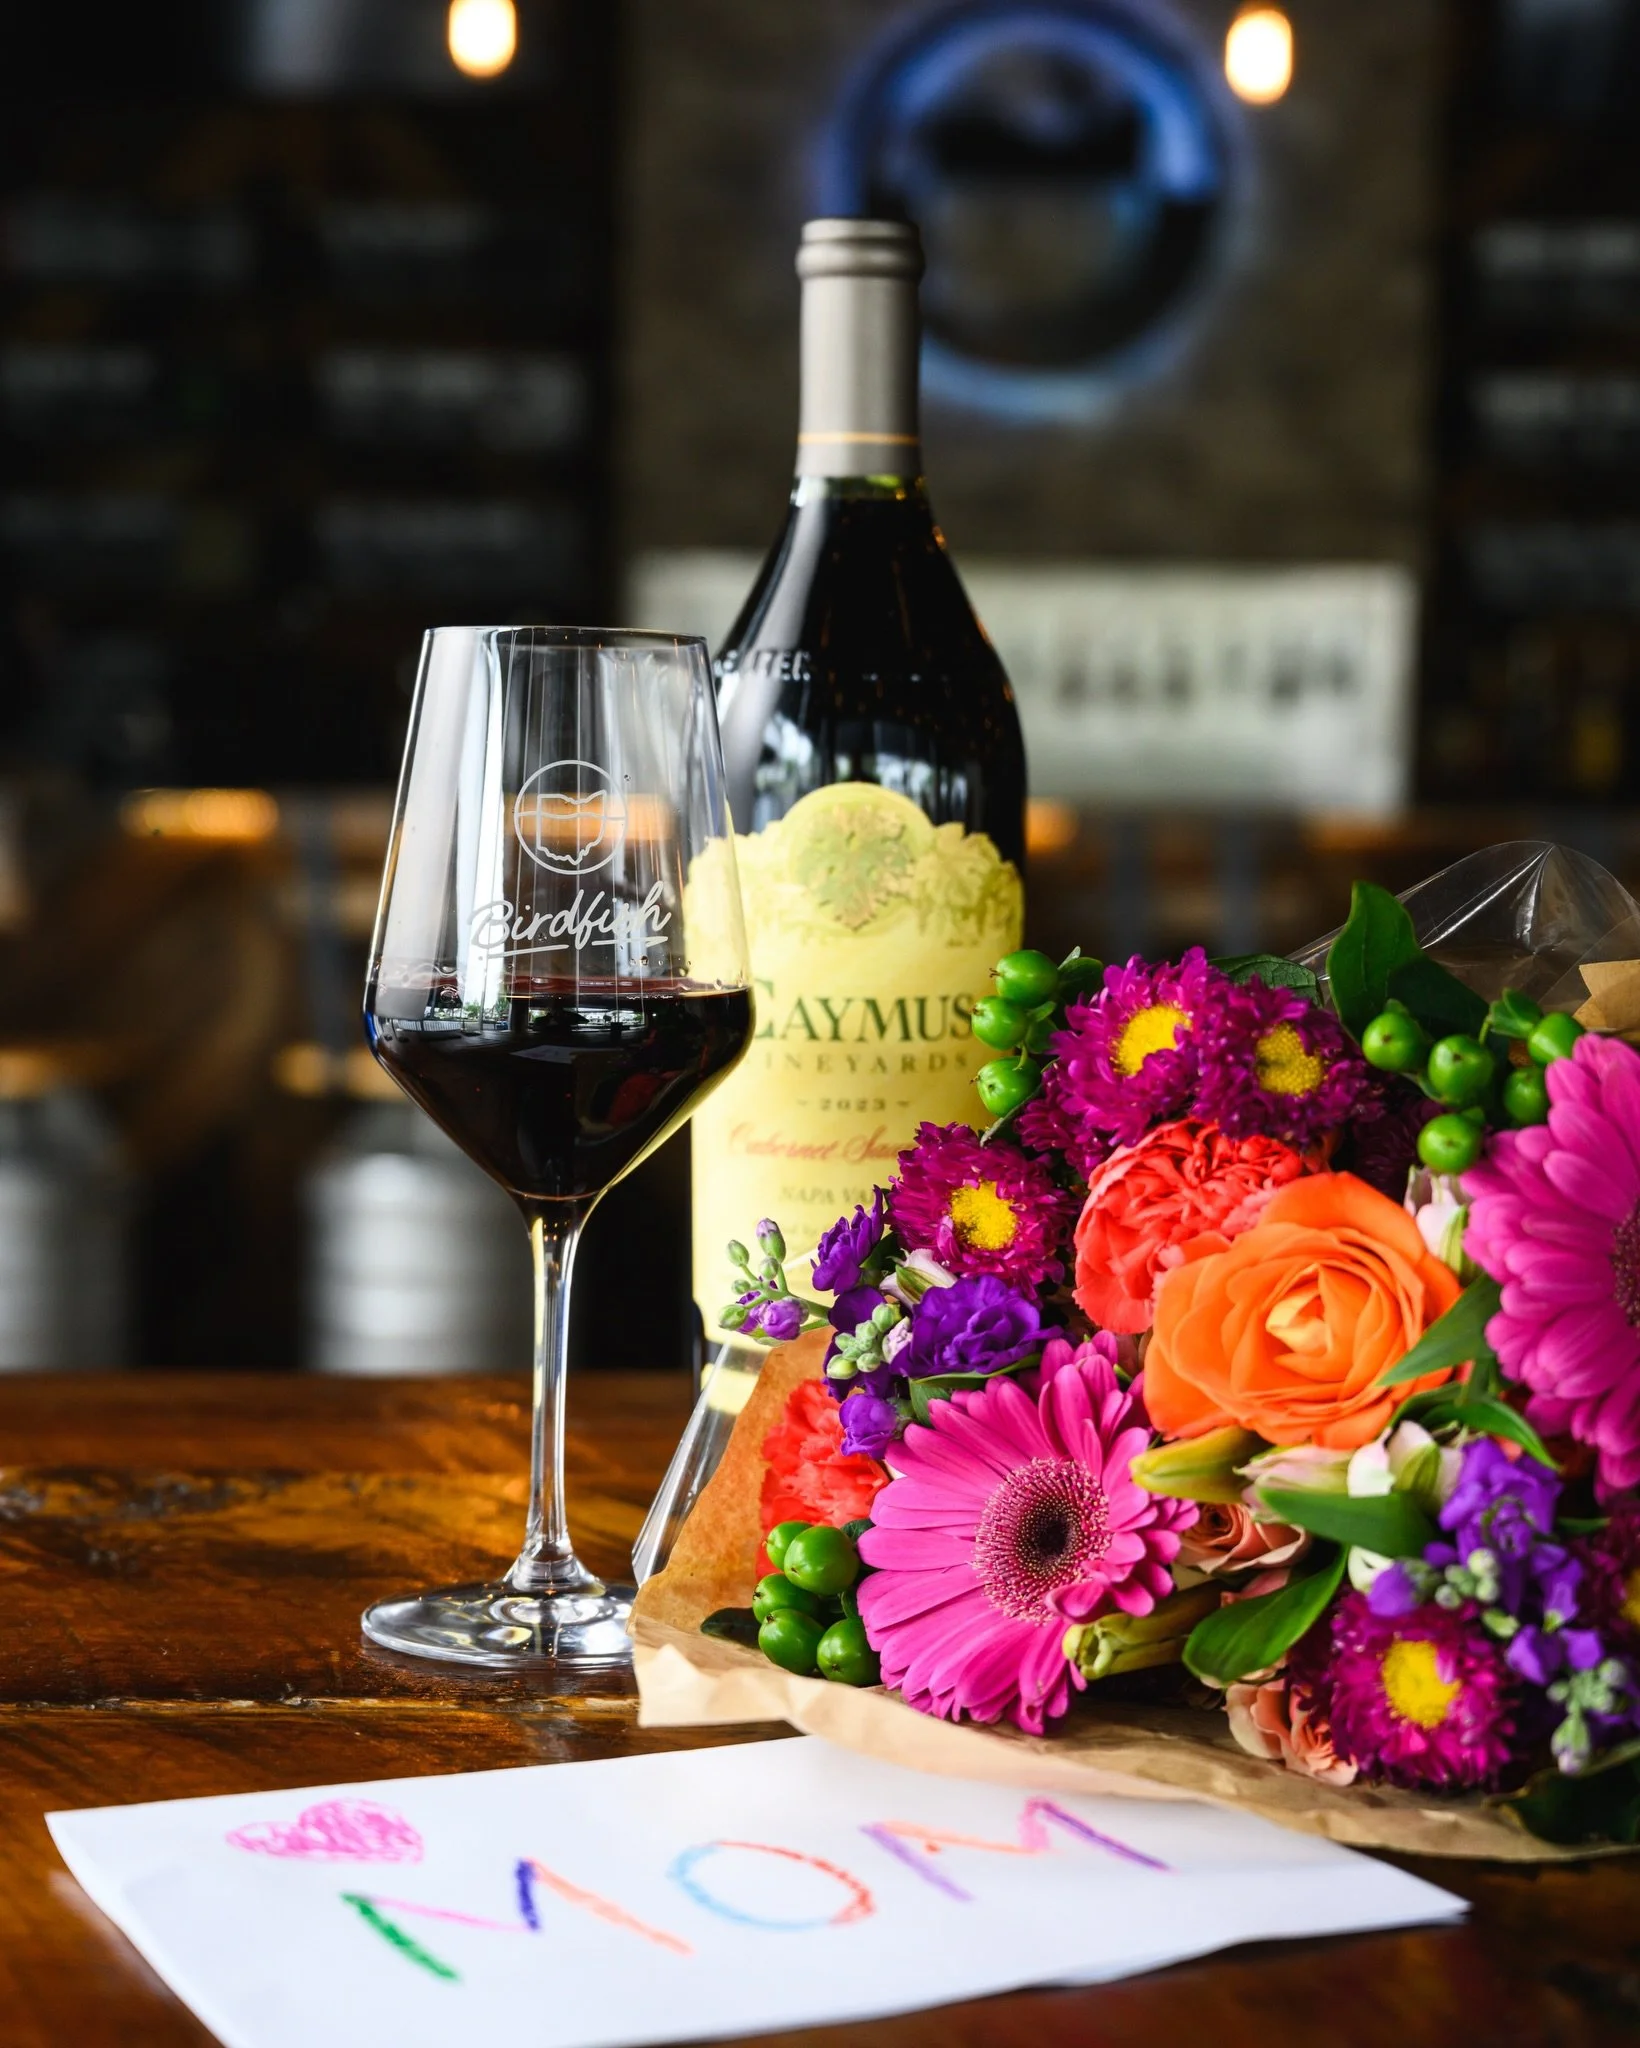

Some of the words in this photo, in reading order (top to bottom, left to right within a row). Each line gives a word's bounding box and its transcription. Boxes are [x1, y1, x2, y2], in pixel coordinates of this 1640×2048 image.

[467, 881, 671, 950] Birdfish
[746, 1051, 968, 1074] INEYARDS
[340, 1796, 1177, 1982] MOM
